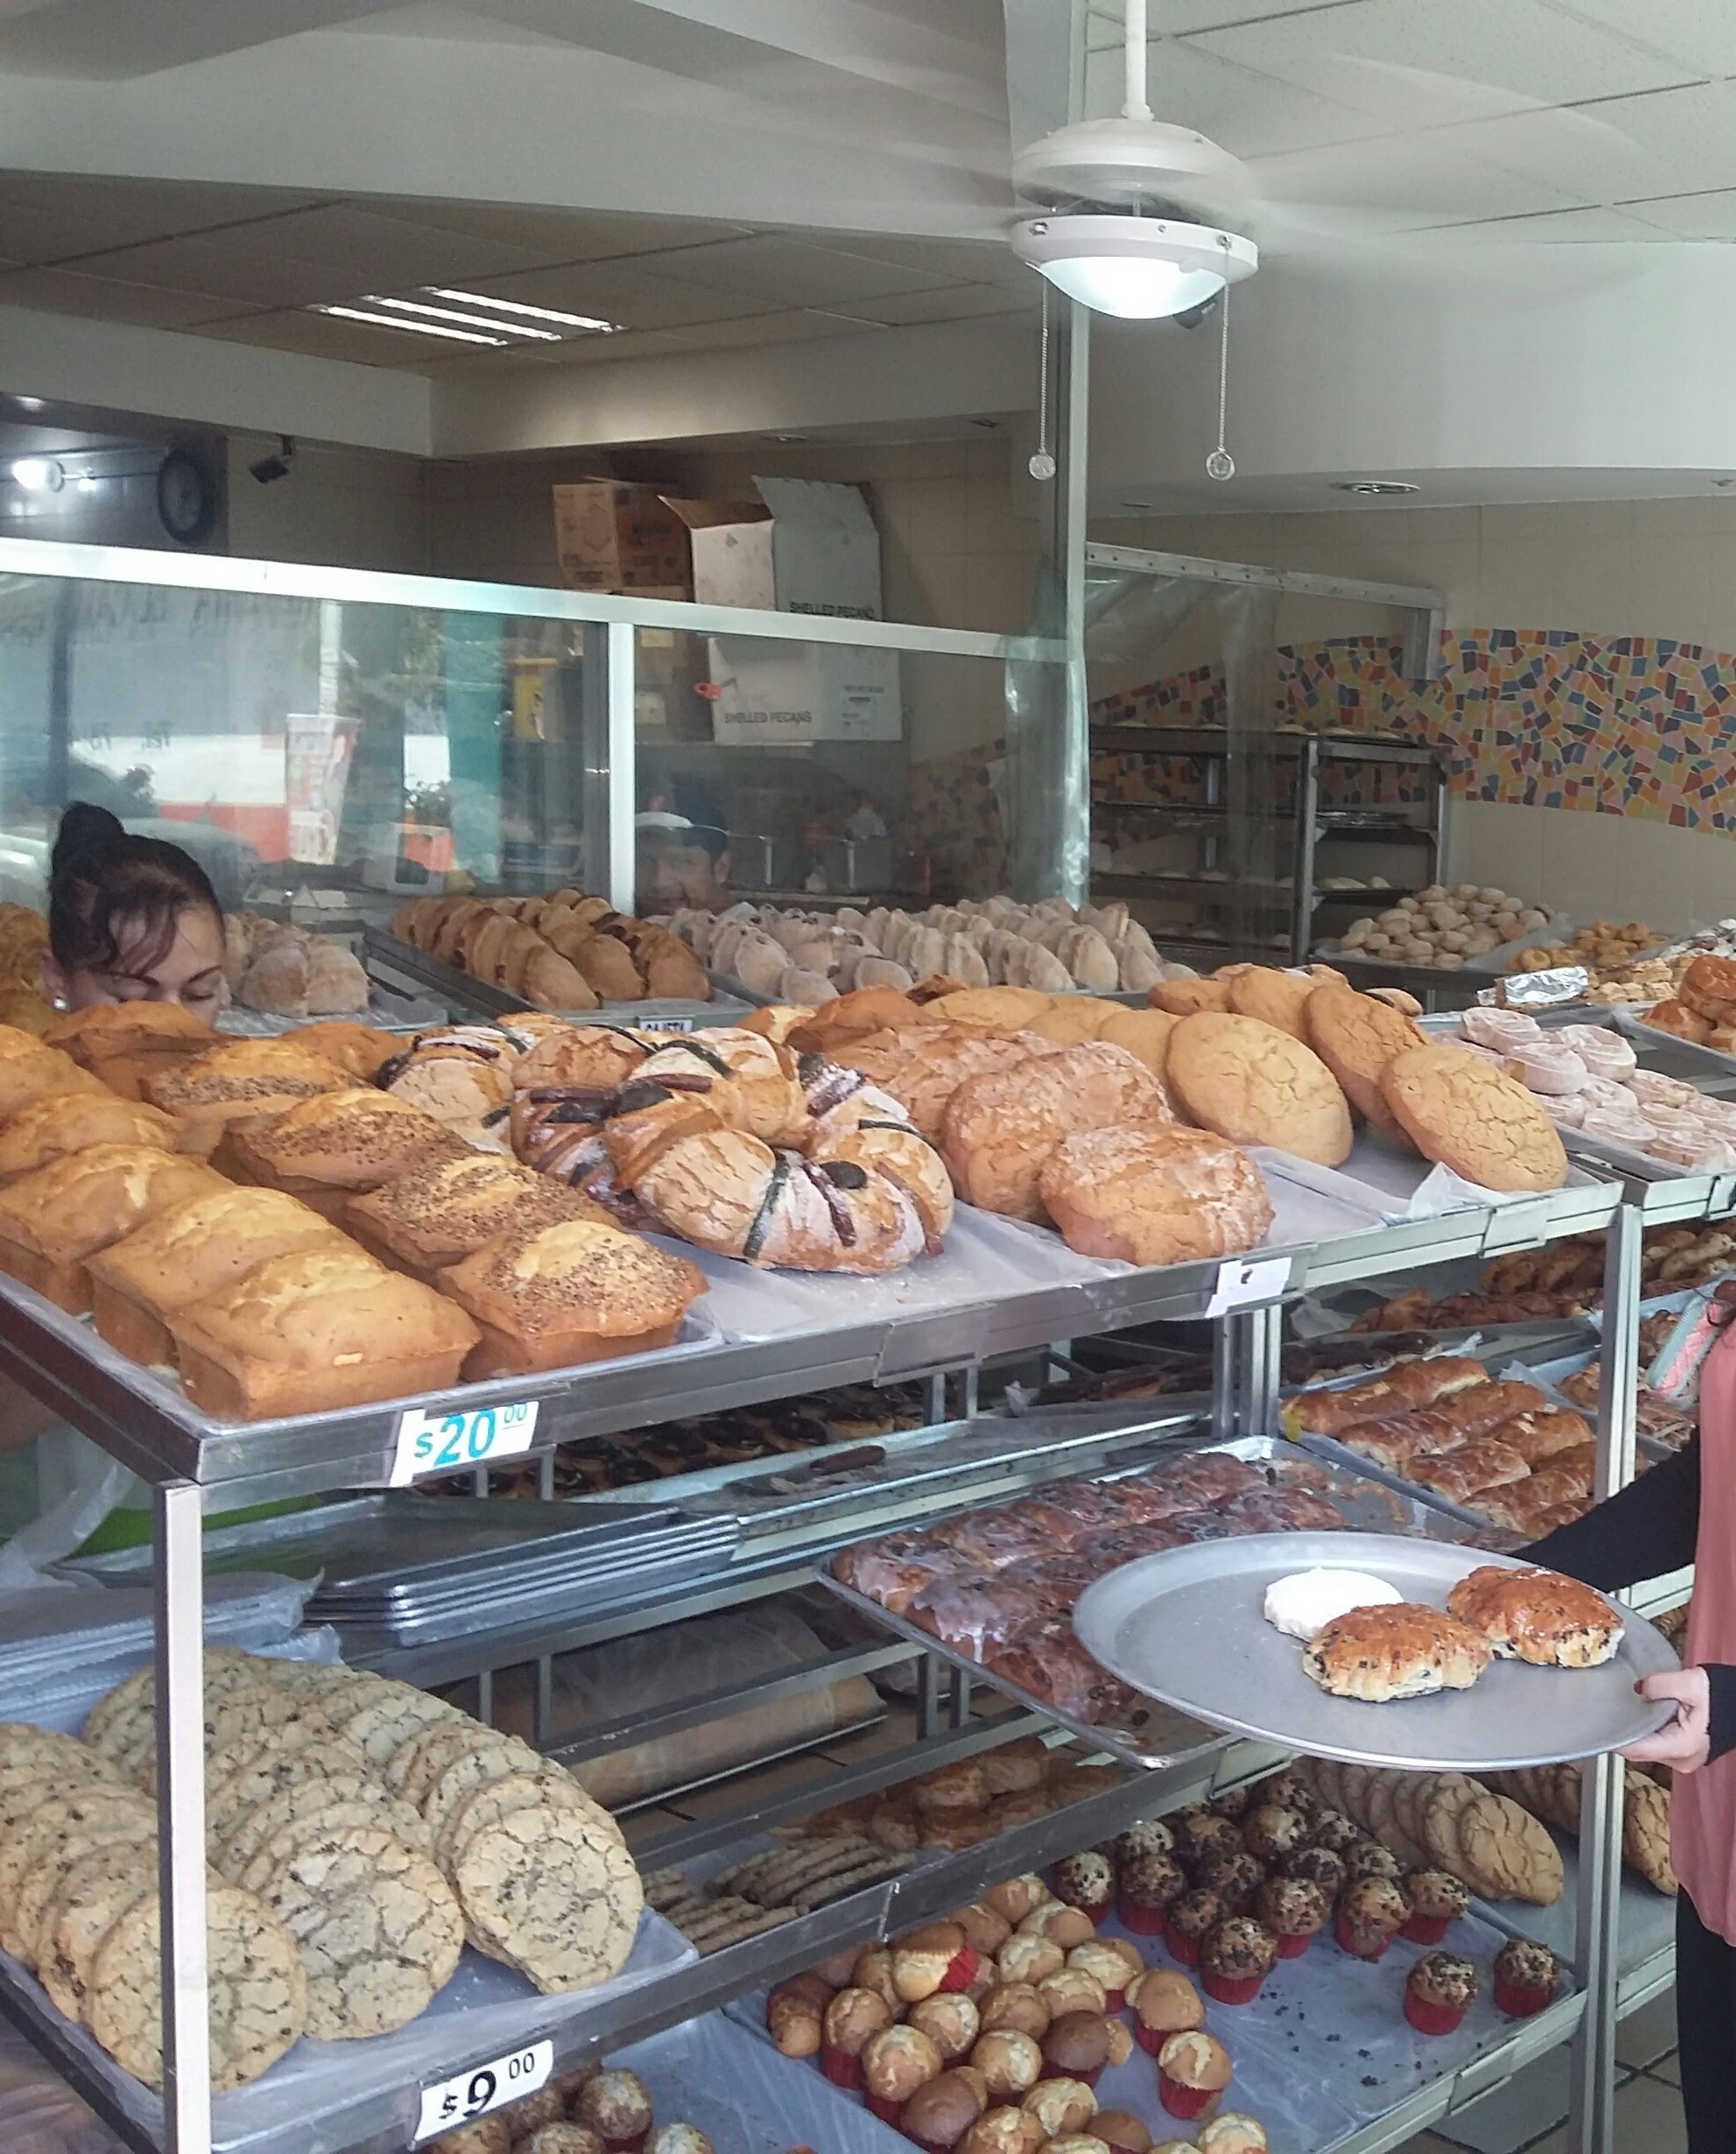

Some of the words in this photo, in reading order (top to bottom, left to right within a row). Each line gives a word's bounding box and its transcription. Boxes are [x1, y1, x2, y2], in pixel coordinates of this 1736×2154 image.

[724, 712, 767, 724] SHELLED
[770, 710, 812, 725] PECANS
[503, 1403, 528, 1424] 00
[508, 2052, 535, 2079] 00
